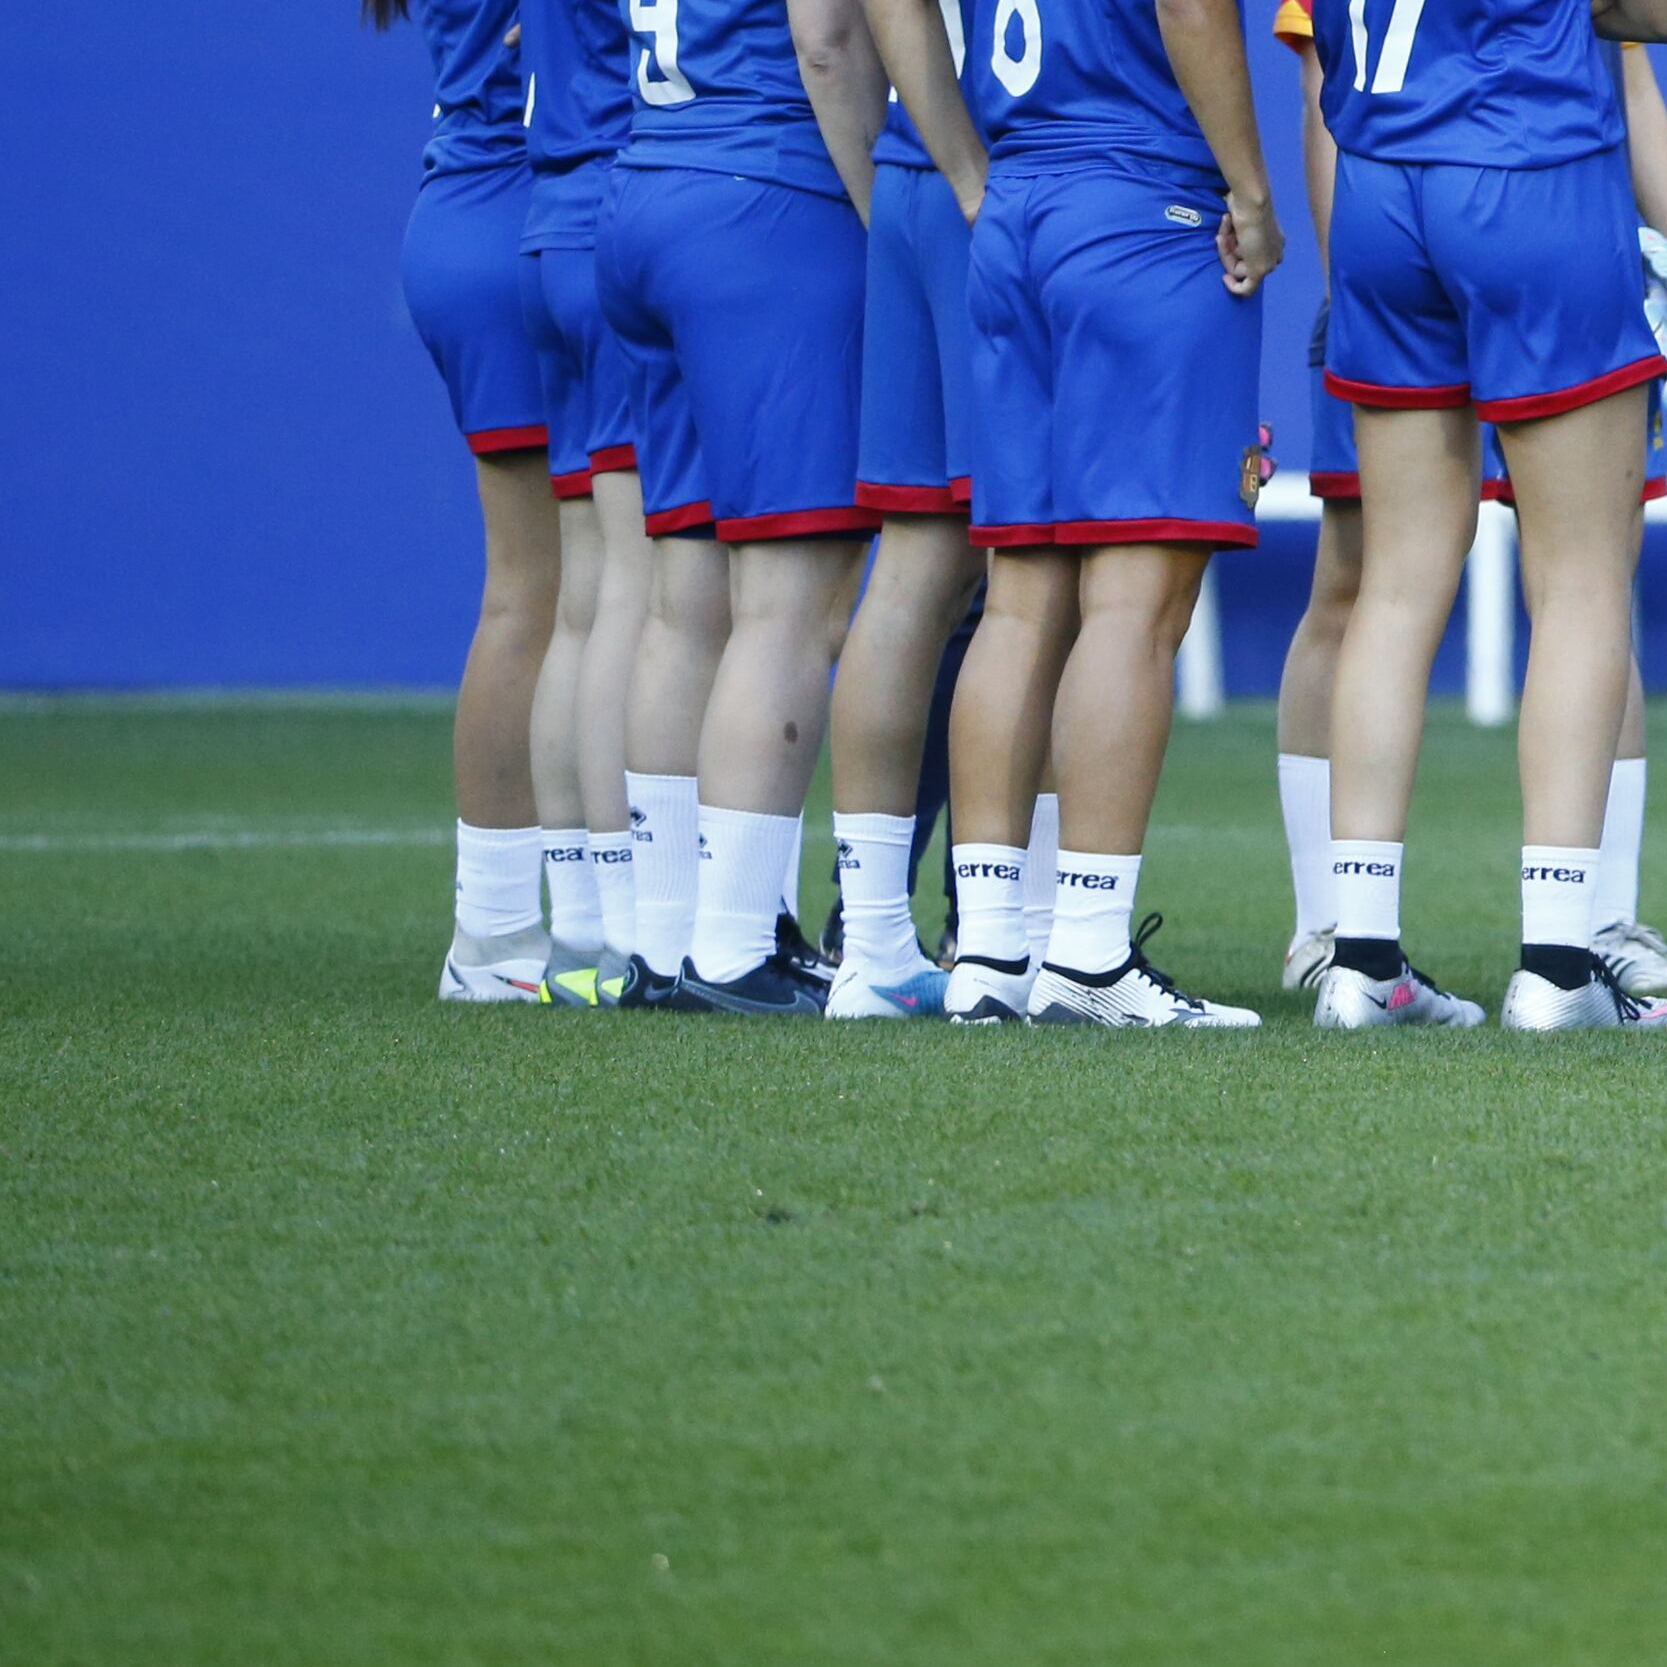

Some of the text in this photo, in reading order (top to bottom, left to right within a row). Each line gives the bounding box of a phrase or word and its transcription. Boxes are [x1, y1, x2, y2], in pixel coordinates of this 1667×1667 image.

[958, 863, 1021, 881] errea
[1333, 861, 1395, 877] errea
[1522, 865, 1587, 883] errea
